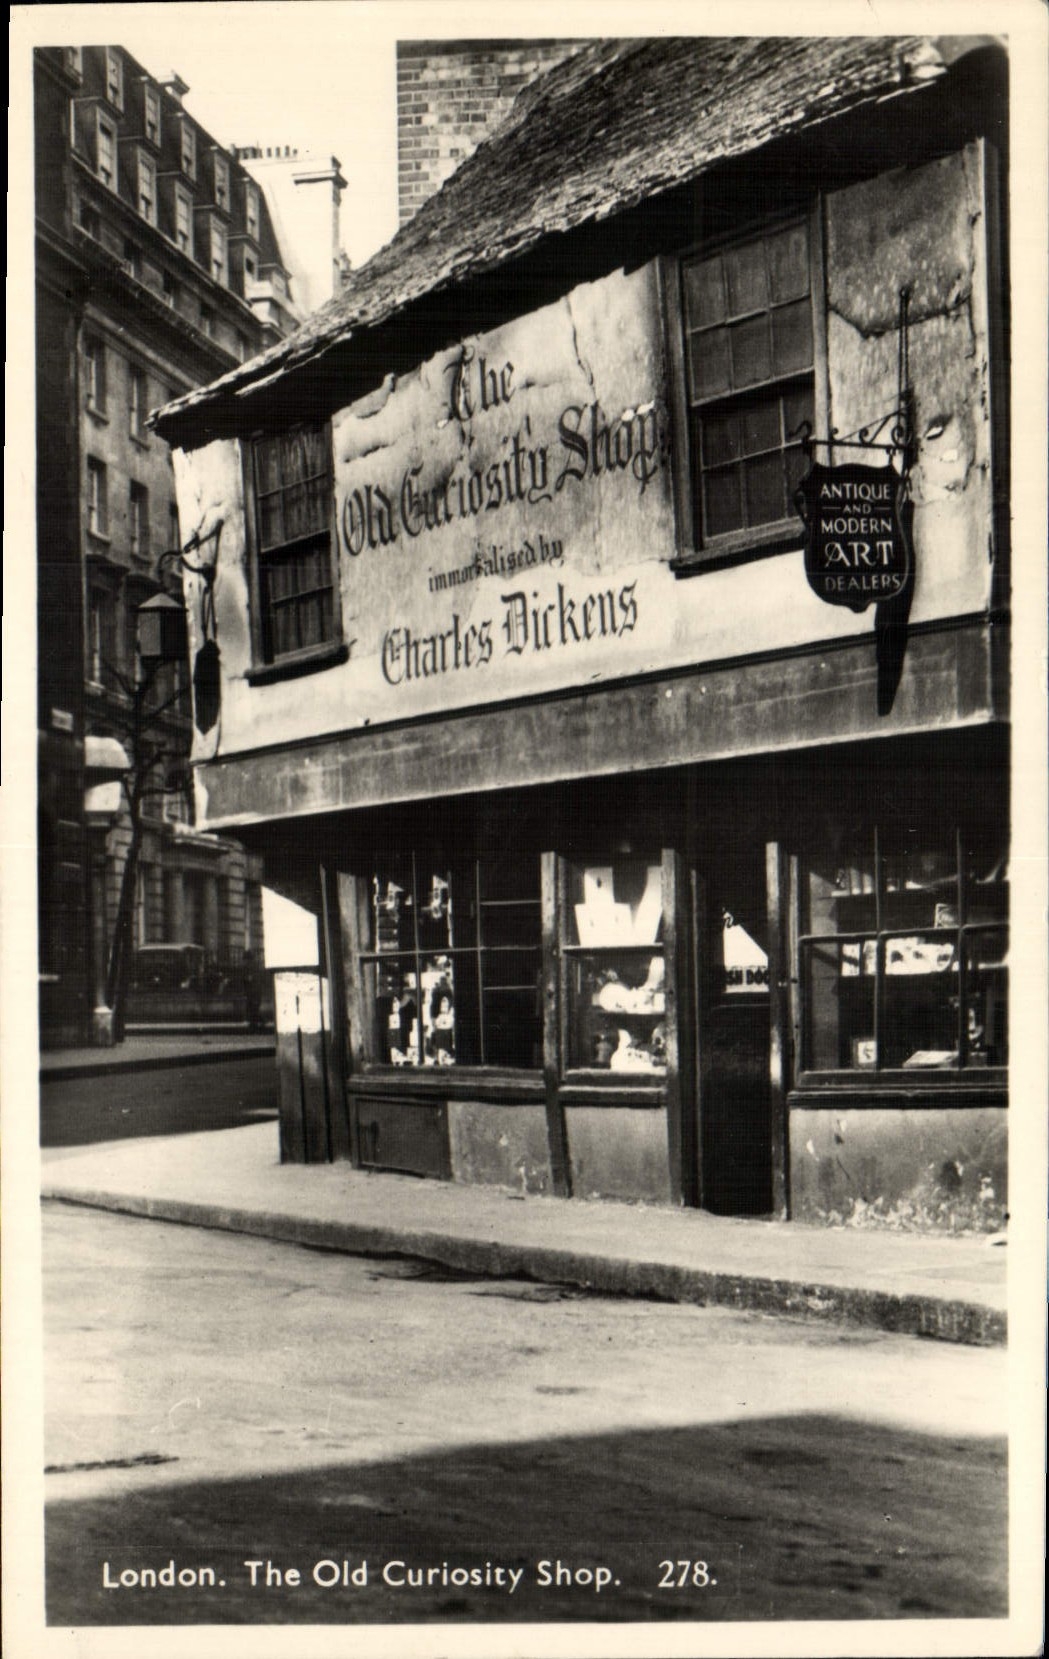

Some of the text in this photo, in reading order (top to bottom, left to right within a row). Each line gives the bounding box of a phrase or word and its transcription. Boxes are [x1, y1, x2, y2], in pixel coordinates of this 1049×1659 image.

[442, 345, 516, 420] The
[343, 400, 659, 556] Old Curiosity Shop
[820, 483, 890, 502] ANTIQUE
[842, 503, 872, 515] AND
[821, 517, 892, 535] MODERN
[429, 534, 565, 592] immortalised by
[824, 541, 894, 568] ART
[825, 574, 901, 591] DEALERS
[382, 580, 638, 685] Charles Dickens
